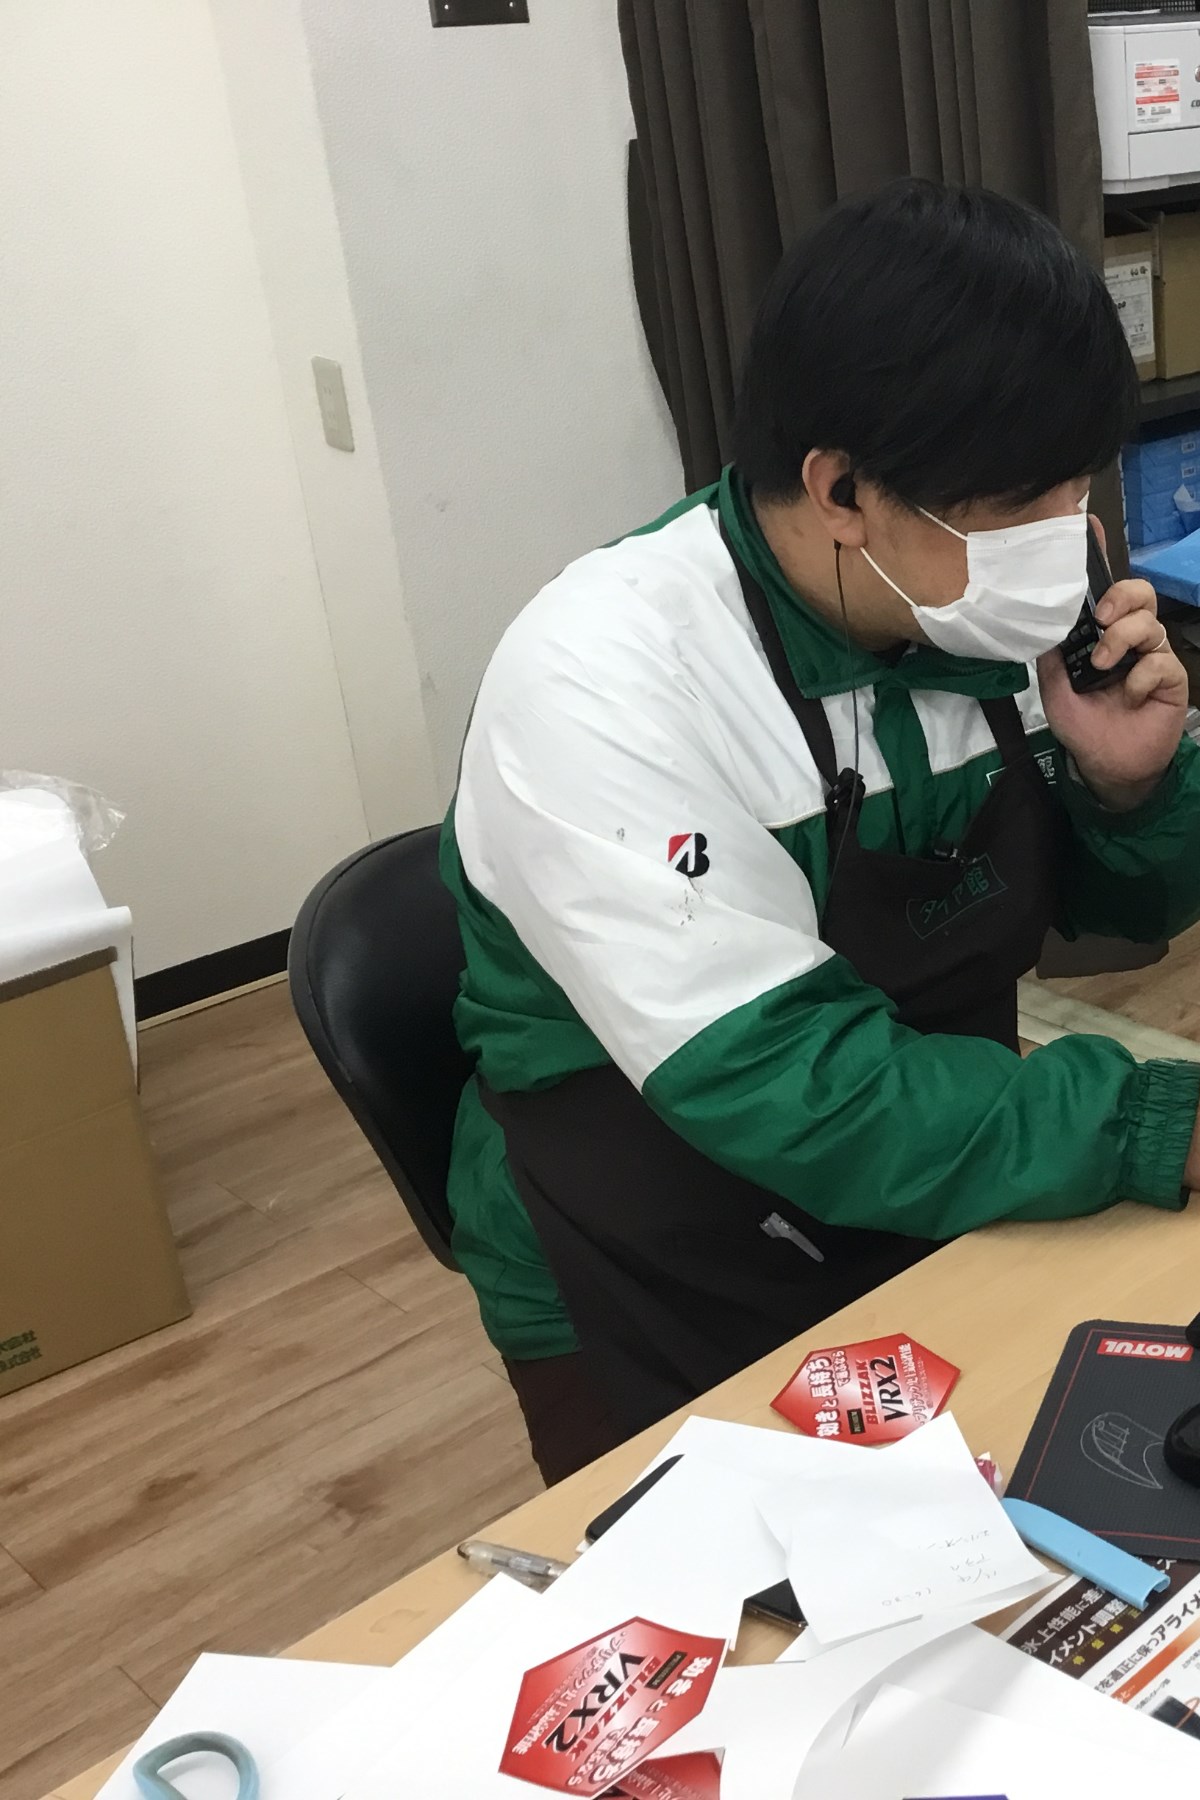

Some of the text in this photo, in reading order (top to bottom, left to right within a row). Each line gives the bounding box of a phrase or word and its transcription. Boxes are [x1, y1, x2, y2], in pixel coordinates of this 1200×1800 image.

[919, 866, 990, 924] タイヤ館
[832, 1350, 852, 1387] で選ぶなら
[1105, 1340, 1190, 1360] MOTUL
[807, 1355, 841, 1438] 効きと長持ち
[855, 1358, 879, 1425] BLIZZAK
[869, 1354, 911, 1424] VRX2
[1021, 1583, 1107, 1656] 氷上性能に差
[543, 1650, 649, 1756] VRX2
[567, 1655, 663, 1763] BLIZZAK
[588, 1655, 714, 1784] 効きと長持ち
[566, 1726, 627, 1787] で選ぶなら
